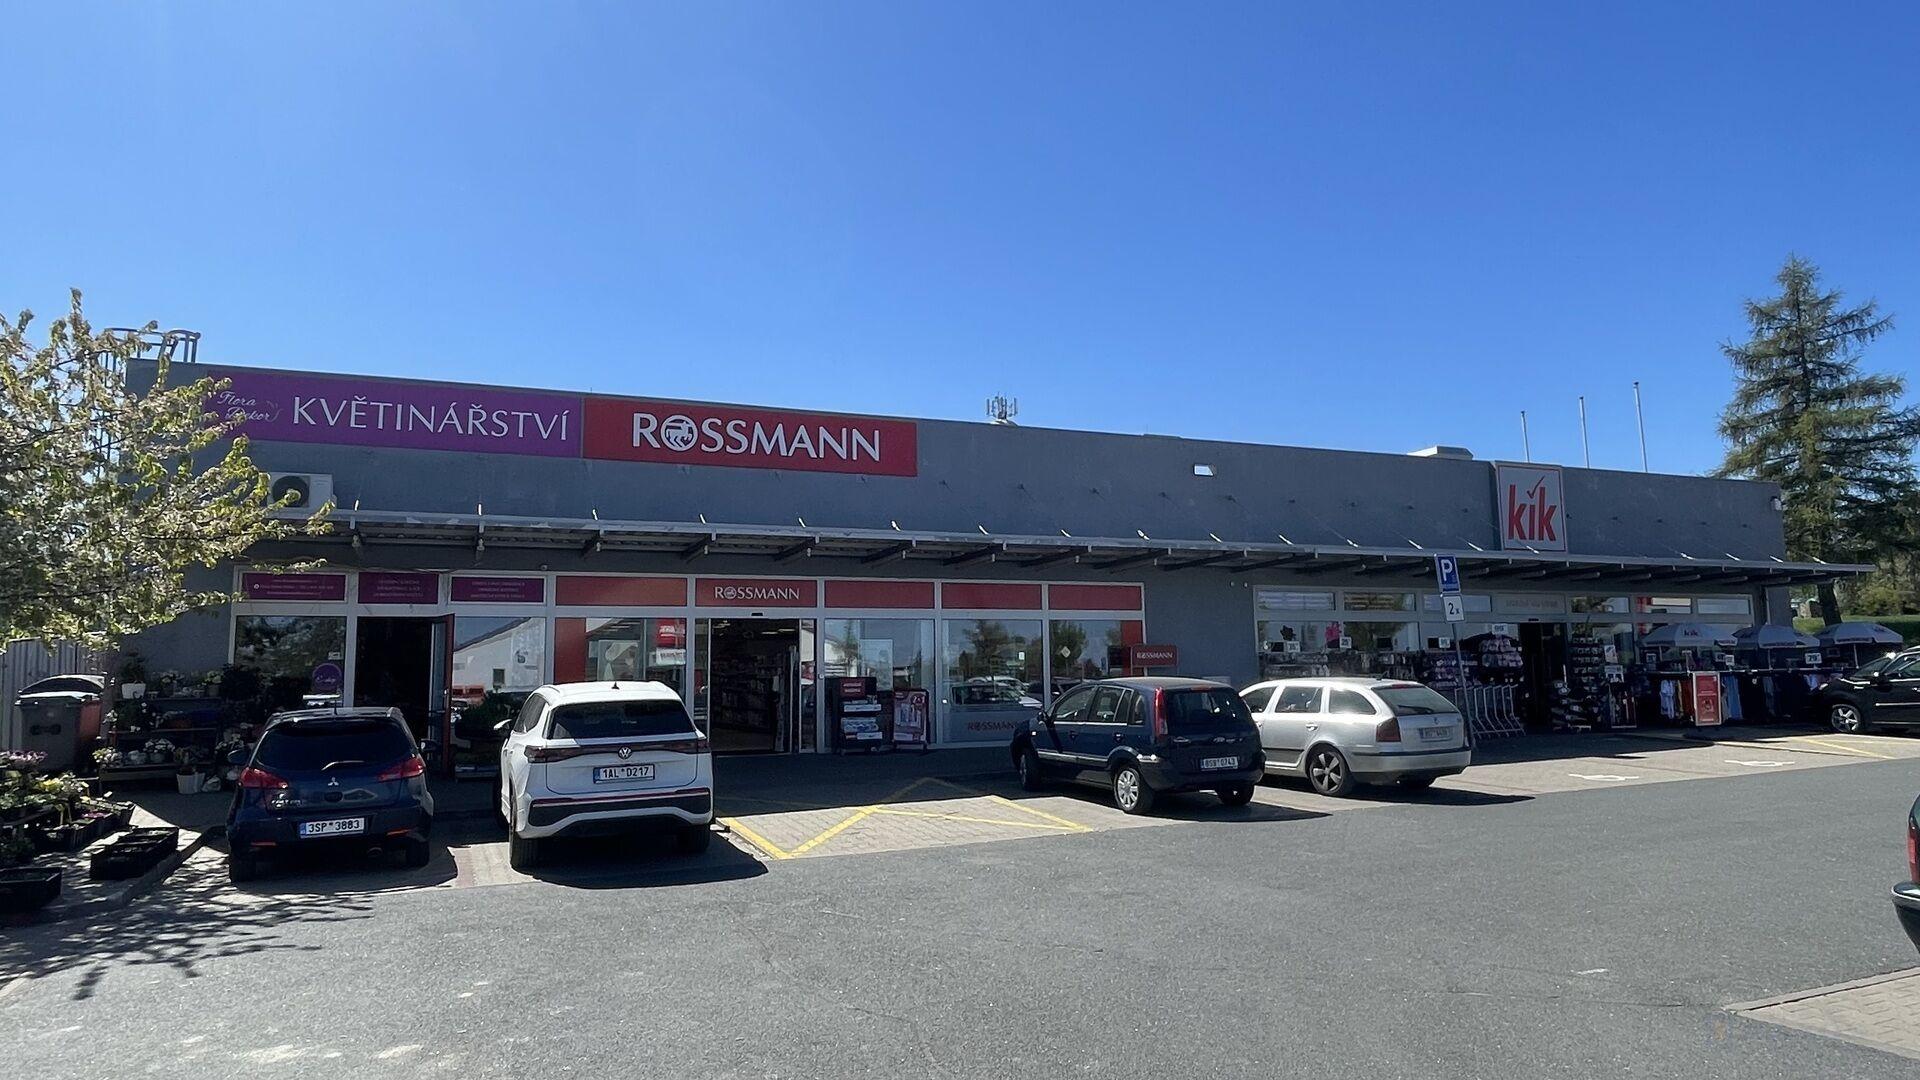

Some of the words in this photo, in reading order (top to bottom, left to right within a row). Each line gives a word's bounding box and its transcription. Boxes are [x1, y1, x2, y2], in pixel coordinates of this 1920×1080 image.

[217, 390, 257, 406] Flora
[293, 396, 570, 441] KVĚTINÁŘSTVÍ
[632, 412, 880, 462] ROSSMANN
[1440, 559, 1453, 581] P
[714, 586, 800, 600] ROSSMANN
[1136, 651, 1173, 660] ROSSMANN
[603, 768, 619, 778] 1AL
[308, 823, 327, 833] 3SP
[335, 820, 360, 831] 3883
